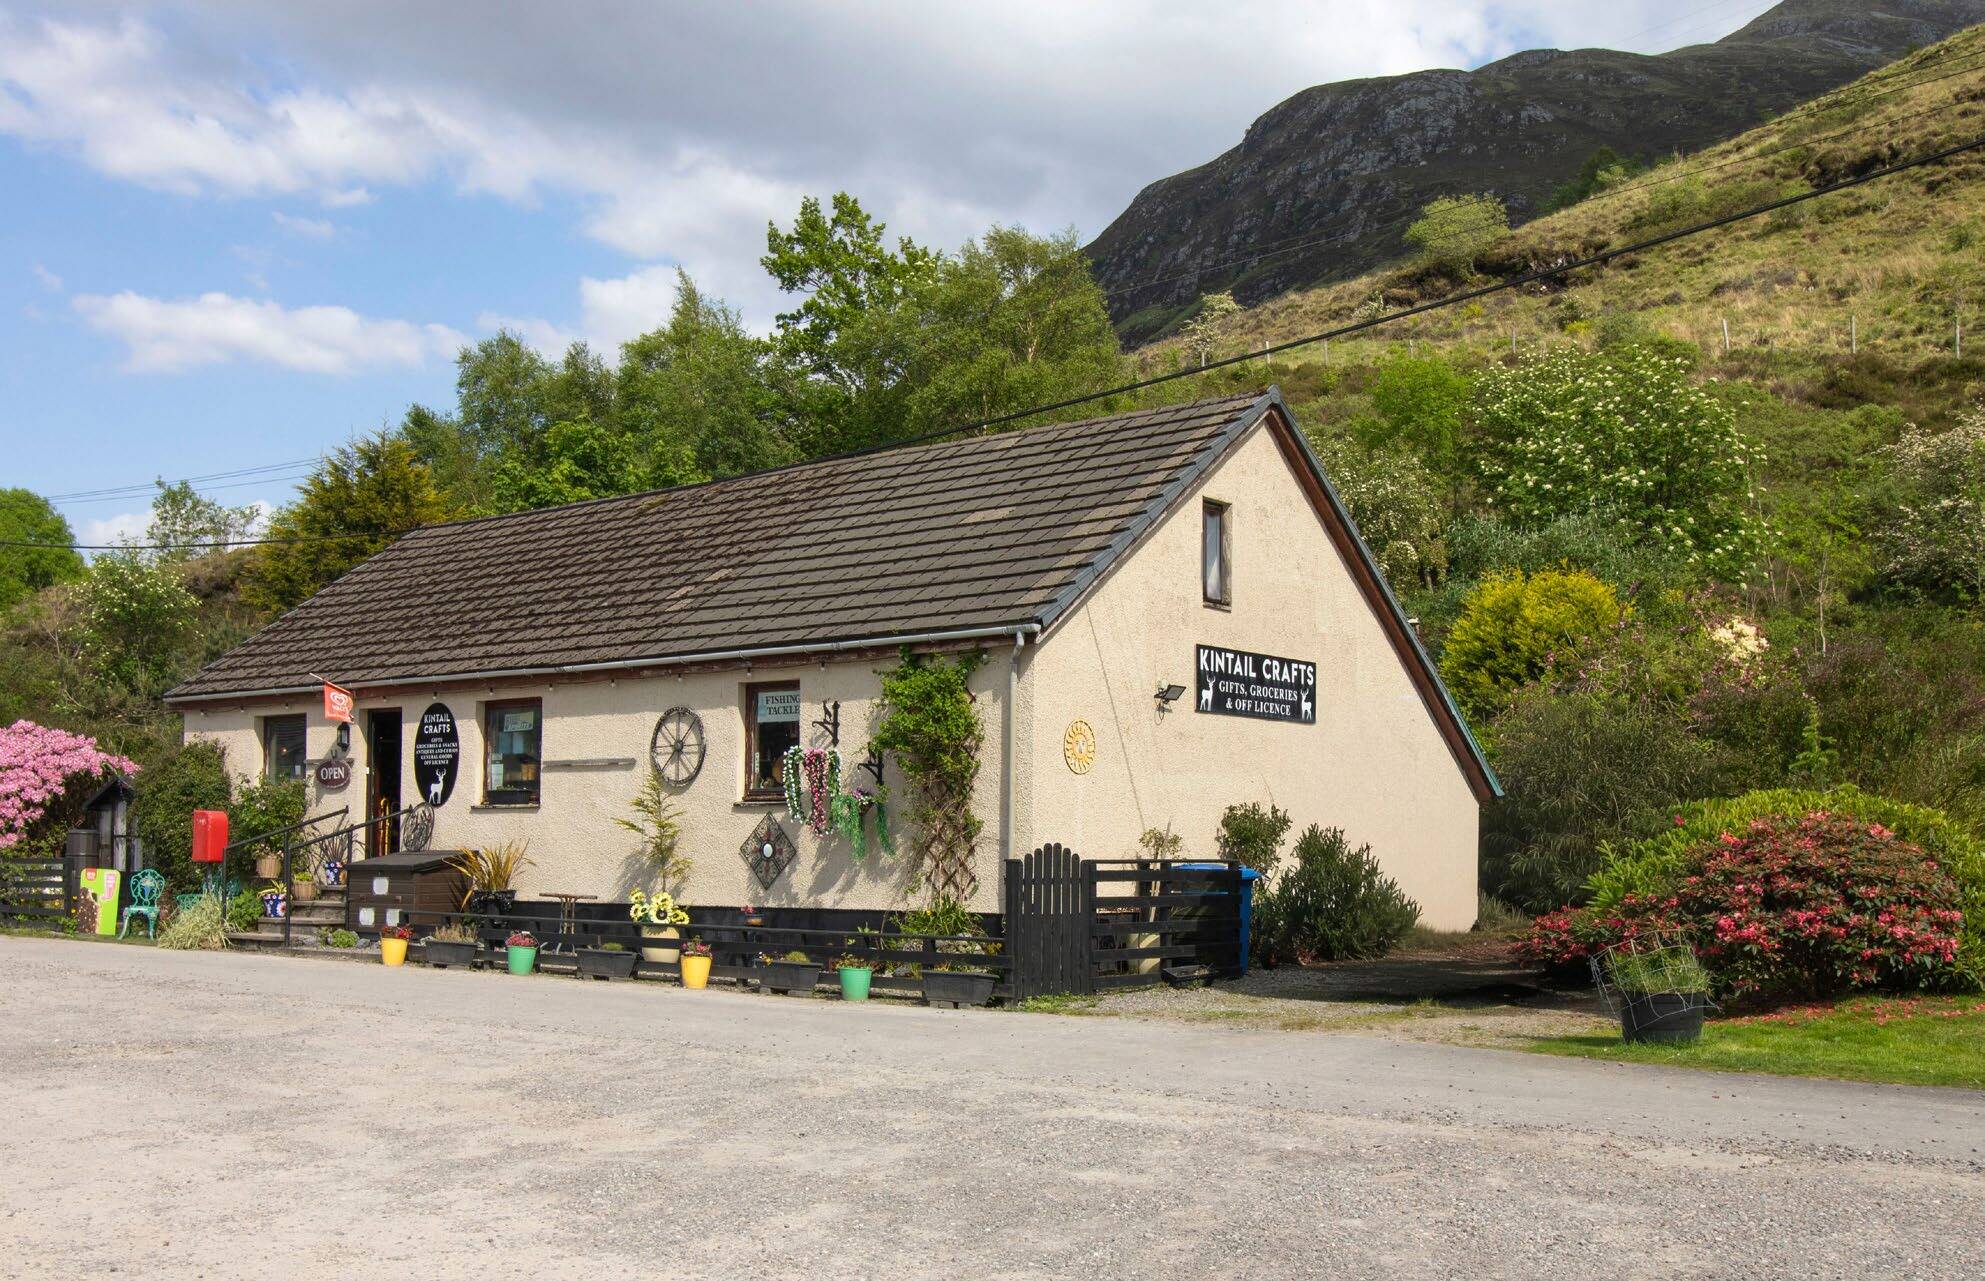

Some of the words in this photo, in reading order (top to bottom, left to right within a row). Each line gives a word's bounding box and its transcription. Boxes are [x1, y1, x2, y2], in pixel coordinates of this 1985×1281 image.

[1200, 648, 1257, 678] KINTAIL
[1262, 658, 1314, 686] CRAFTS
[1218, 680, 1248, 697] GIFTS,
[1249, 684, 1298, 702] GROCERIES
[766, 694, 800, 704] FISHING
[766, 705, 800, 715] TACKLE
[1225, 697, 1233, 710] &
[1235, 698, 1252, 711] OFF
[1254, 701, 1291, 716] LICENCE
[424, 713, 450, 723] KINTAIL
[424, 723, 450, 733] CRAFTS
[321, 767, 345, 780] OPEN
